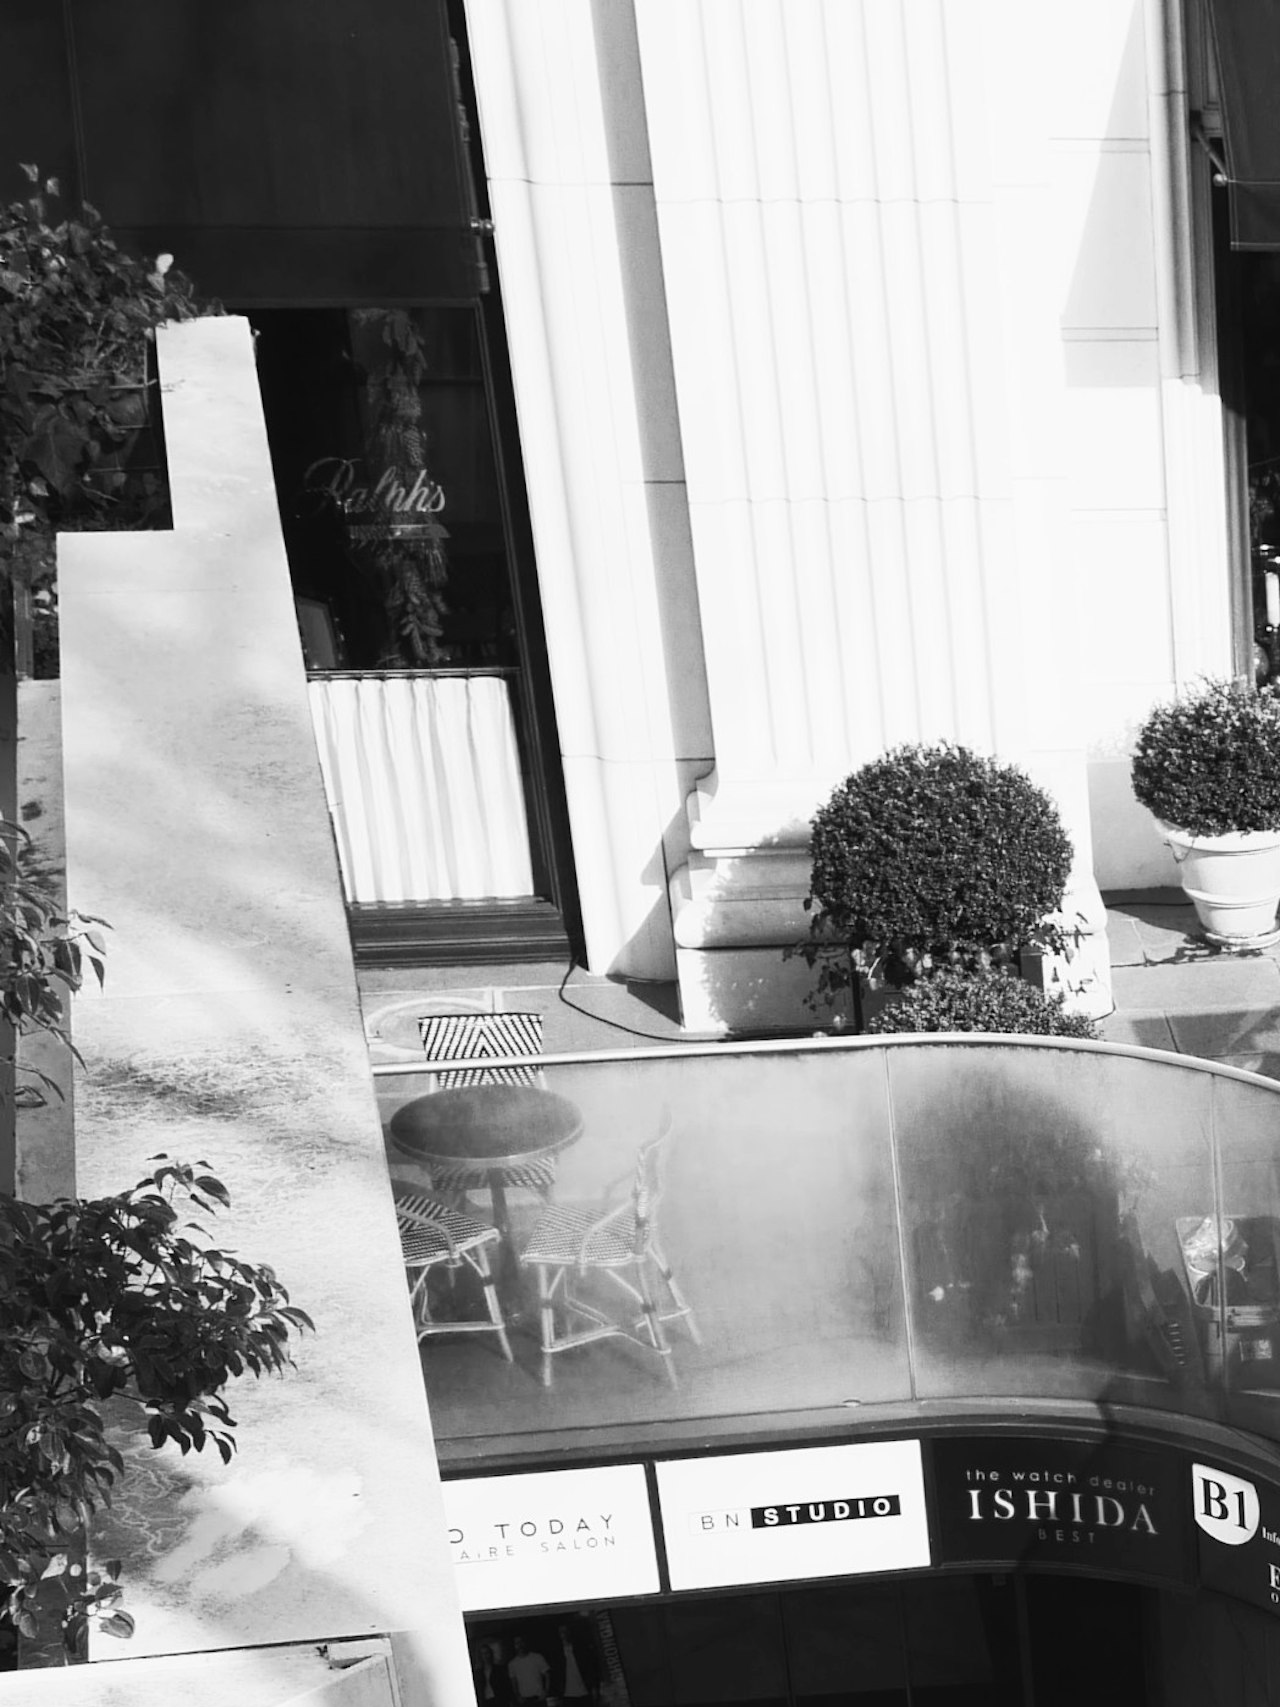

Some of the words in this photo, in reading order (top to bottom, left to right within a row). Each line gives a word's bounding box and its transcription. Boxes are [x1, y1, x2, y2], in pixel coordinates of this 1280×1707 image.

[304, 457, 446, 514] Ralph's
[966, 1469, 999, 1482] the
[1012, 1470, 1077, 1484] watch
[1089, 1475, 1155, 1496] dealer
[701, 1513, 739, 1530] BN
[763, 1497, 891, 1526] STUDIO
[968, 1488, 1159, 1535] ISHIDA
[1200, 1476, 1251, 1531] B1
[494, 1514, 612, 1539] TODAY
[1038, 1528, 1095, 1543] BEST
[540, 1536, 615, 1553] SALON
[597, 1608, 623, 1682] CHRONOMA
